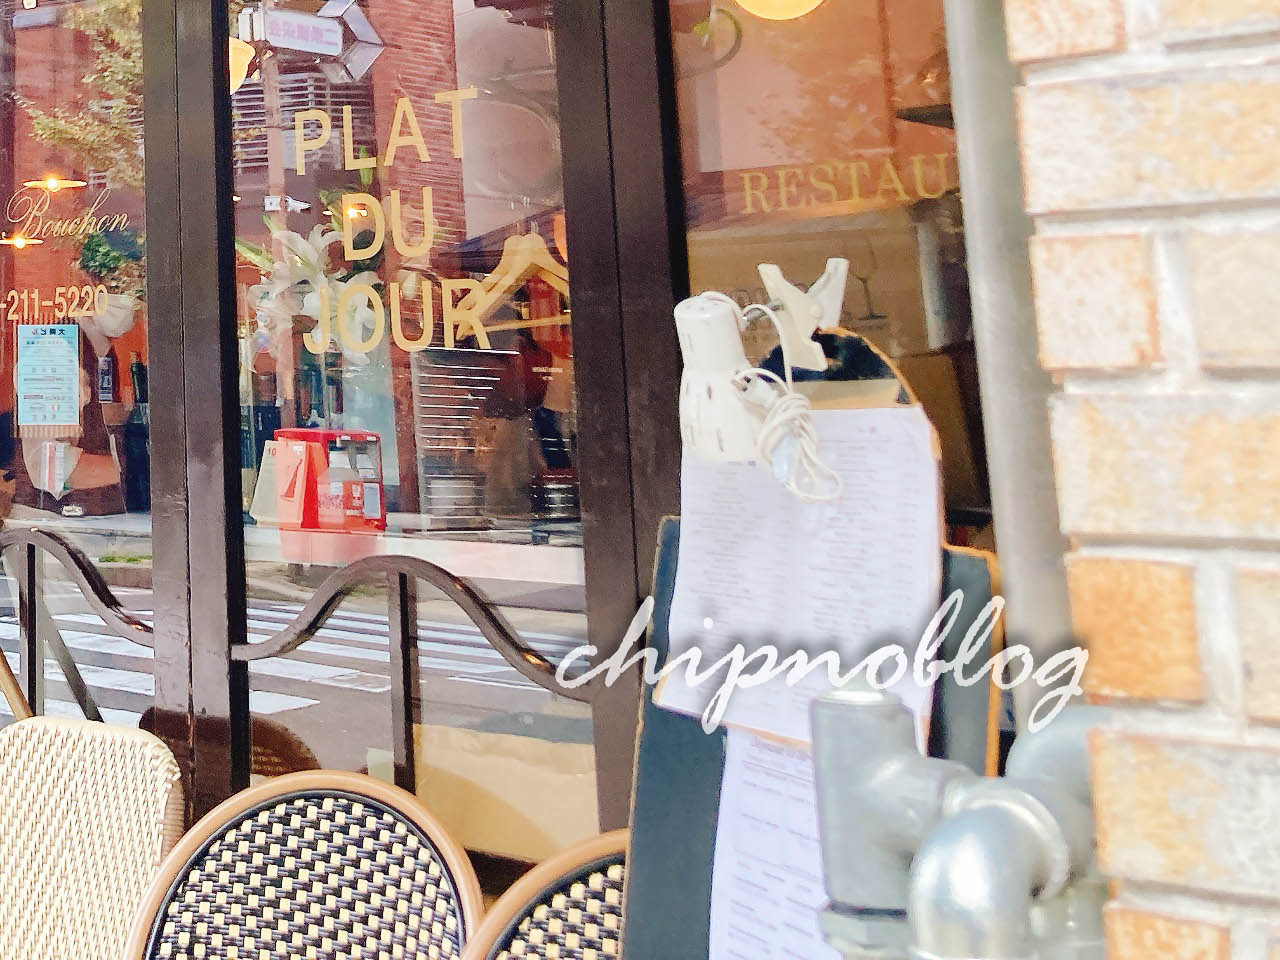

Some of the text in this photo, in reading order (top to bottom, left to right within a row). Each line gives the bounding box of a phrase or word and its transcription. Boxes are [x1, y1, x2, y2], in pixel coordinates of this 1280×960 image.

[294, 87, 478, 176] PLAT
[7, 186, 130, 239] Bouchon
[739, 152, 956, 215] RESTAU
[341, 186, 434, 261] DU
[302, 278, 492, 355] JOUR
